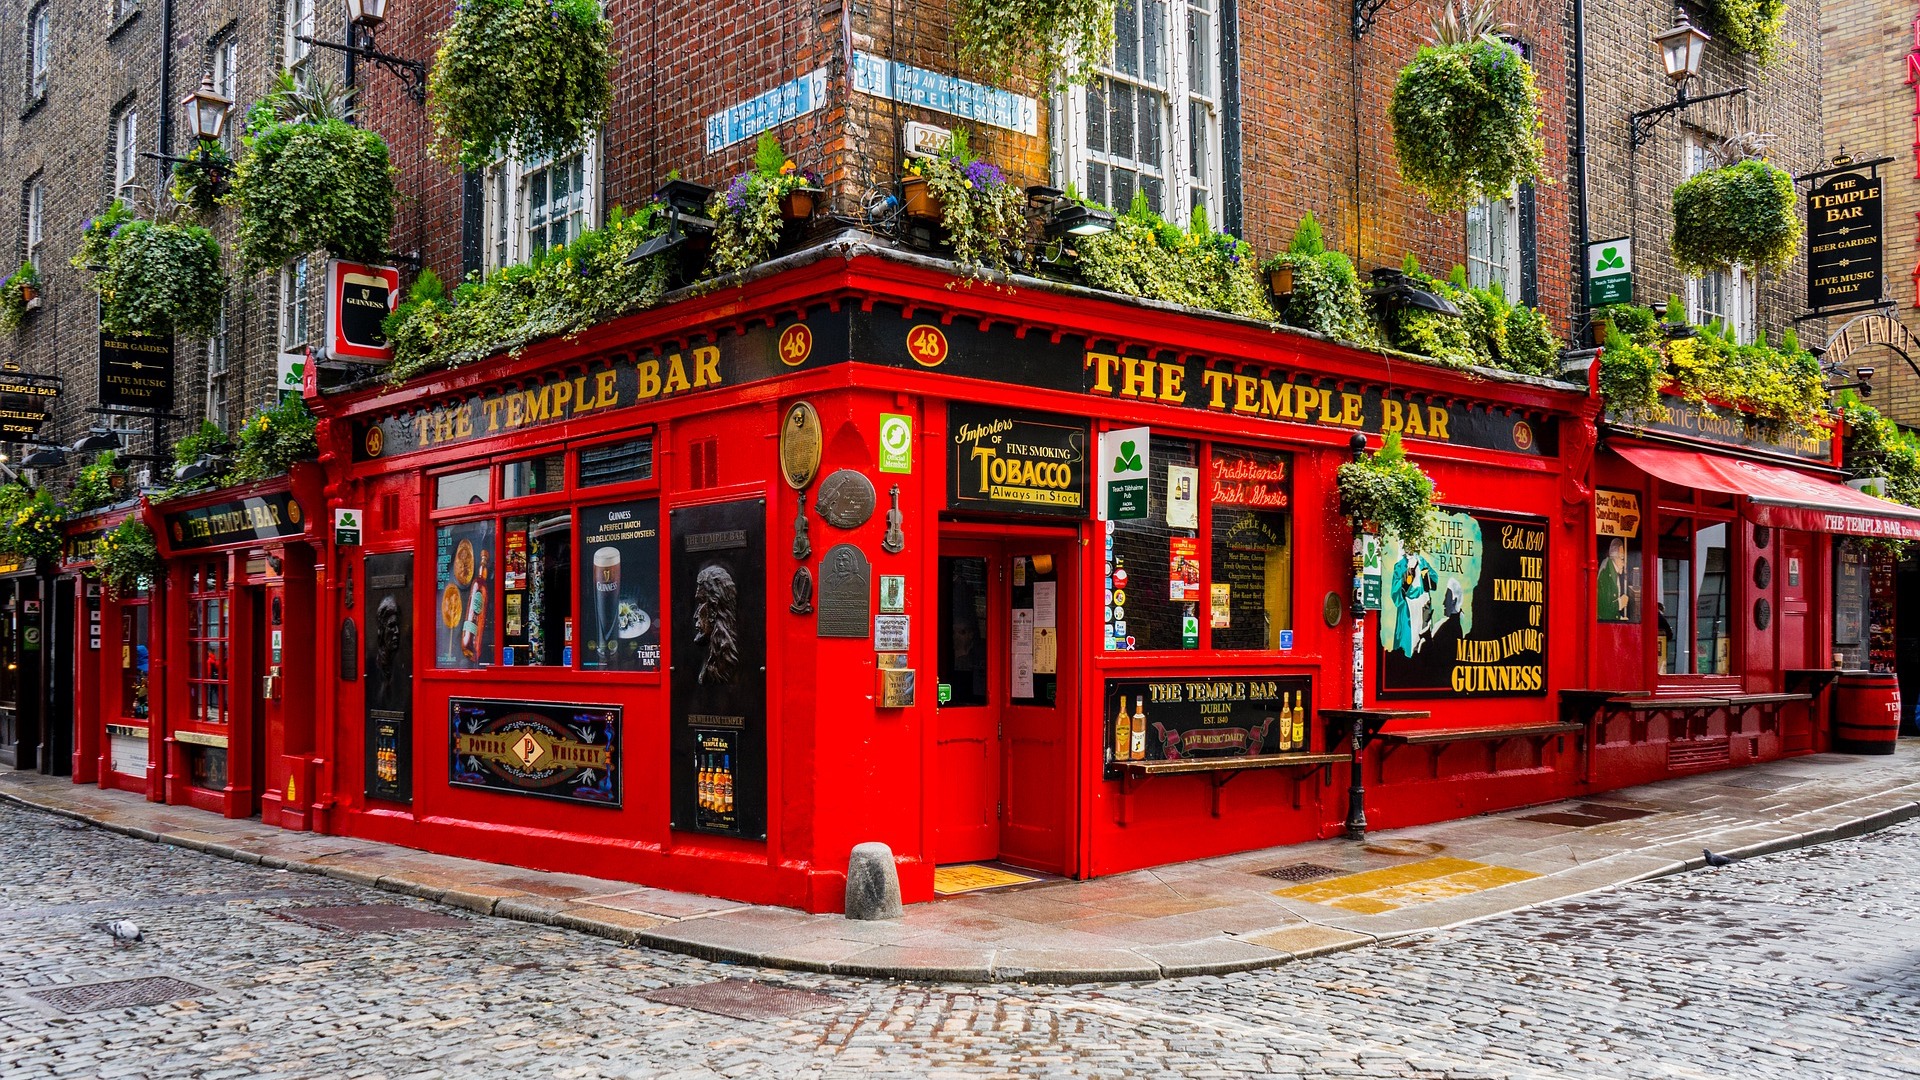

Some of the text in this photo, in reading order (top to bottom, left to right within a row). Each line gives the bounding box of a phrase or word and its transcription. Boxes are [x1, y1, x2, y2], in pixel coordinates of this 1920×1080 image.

[815, 80, 822, 98] 2
[922, 75, 936, 89] AN
[895, 83, 938, 106] TEMPLE
[741, 111, 774, 132] TEMPLE
[1025, 108, 1032, 126] 2
[1833, 180, 1856, 191] THE
[1811, 188, 1880, 209] TEMPLE
[1827, 207, 1864, 222] BAR
[1812, 236, 1877, 254] BEER GARDEN
[1815, 271, 1874, 287] LIVE MUSIC
[1828, 283, 1860, 295] DAILY
[346, 297, 384, 309] GUINNESS
[104, 340, 169, 354] BEER GARDEN
[784, 332, 806, 358] 48
[914, 330, 939, 356] 48
[107, 375, 167, 388] LIVE MUSIC
[37, 387, 57, 397] BAR
[121, 387, 153, 397] DAILY
[415, 346, 722, 446] THE TEMPLE BAR
[1086, 351, 1451, 440] THE TEMPLE BAR
[3, 424, 34, 433] STORE
[955, 418, 1013, 446] Importers
[991, 435, 1003, 444] OF
[1006, 443, 1070, 460] FINE SMOKING
[970, 446, 1071, 494] TOBACCO
[1212, 459, 1284, 481] Traditional
[992, 488, 1079, 504] Always in Stock
[1112, 485, 1124, 493] Teach
[1211, 481, 1288, 506] Irish Music
[1596, 493, 1609, 506] Beer
[1610, 495, 1631, 509] Garden
[190, 517, 211, 538] THE
[211, 509, 254, 536] TEMPLE
[253, 504, 282, 529] BAR
[608, 510, 632, 521] GUINNESS
[1596, 507, 1620, 524] Smoking
[603, 522, 624, 532] PERFECT
[624, 520, 641, 529] MATCH
[1226, 518, 1278, 543] TEMPLE BAR
[1439, 520, 1463, 538] THE
[1600, 522, 1615, 534] Area
[1825, 514, 1845, 531] THE
[1845, 516, 1883, 534] TEMPLE
[1882, 520, 1902, 536] BAR
[586, 529, 656, 544] FOR DELICIOUS IRISH OYSTERS
[685, 531, 745, 546] THE TEMPLE BAR
[1525, 530, 1544, 551] 1840
[1439, 555, 1464, 574] BAR
[1520, 556, 1542, 579] THE
[1493, 578, 1543, 603] EMPEROR
[1529, 604, 1542, 627] OF
[1455, 628, 1544, 663] MALTED LIQUORS
[637, 651, 660, 659] TEMPLE
[1451, 665, 1542, 692] GUINNESS
[1149, 681, 1279, 704] THE TEMPLE BAR
[1200, 703, 1231, 714] DUBLIN
[721, 716, 744, 725] TEMPLE
[1217, 716, 1229, 724] 1840
[469, 737, 506, 755] POWERS
[1184, 733, 1244, 745] LIVE MUSIC DAILY
[524, 737, 535, 763] P
[551, 743, 600, 763] WHISKEY
